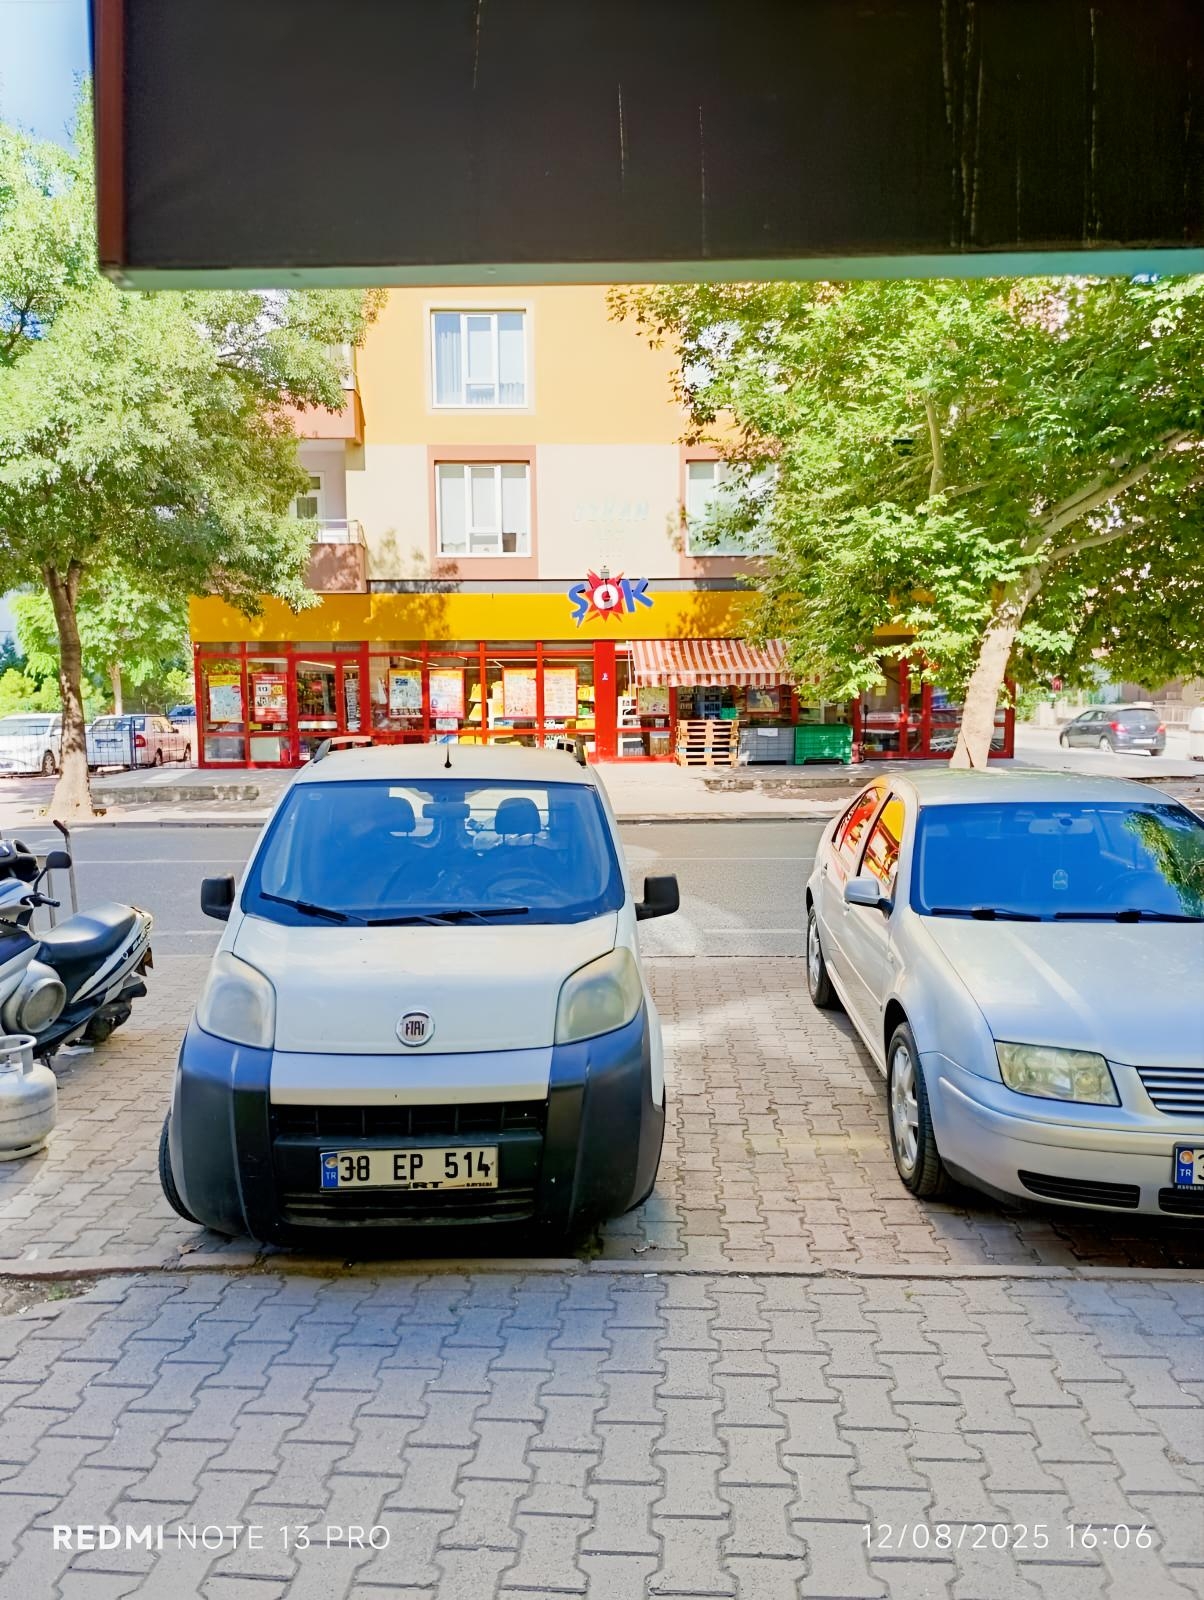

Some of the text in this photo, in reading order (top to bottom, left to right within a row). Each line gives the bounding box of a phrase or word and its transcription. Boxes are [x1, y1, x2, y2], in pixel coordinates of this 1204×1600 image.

[568, 575, 654, 628] ŞOK
[405, 1020, 425, 1036] FIAT
[325, 1151, 491, 1182] TR 38 EP 514
[1180, 1168, 1192, 1177] TR
